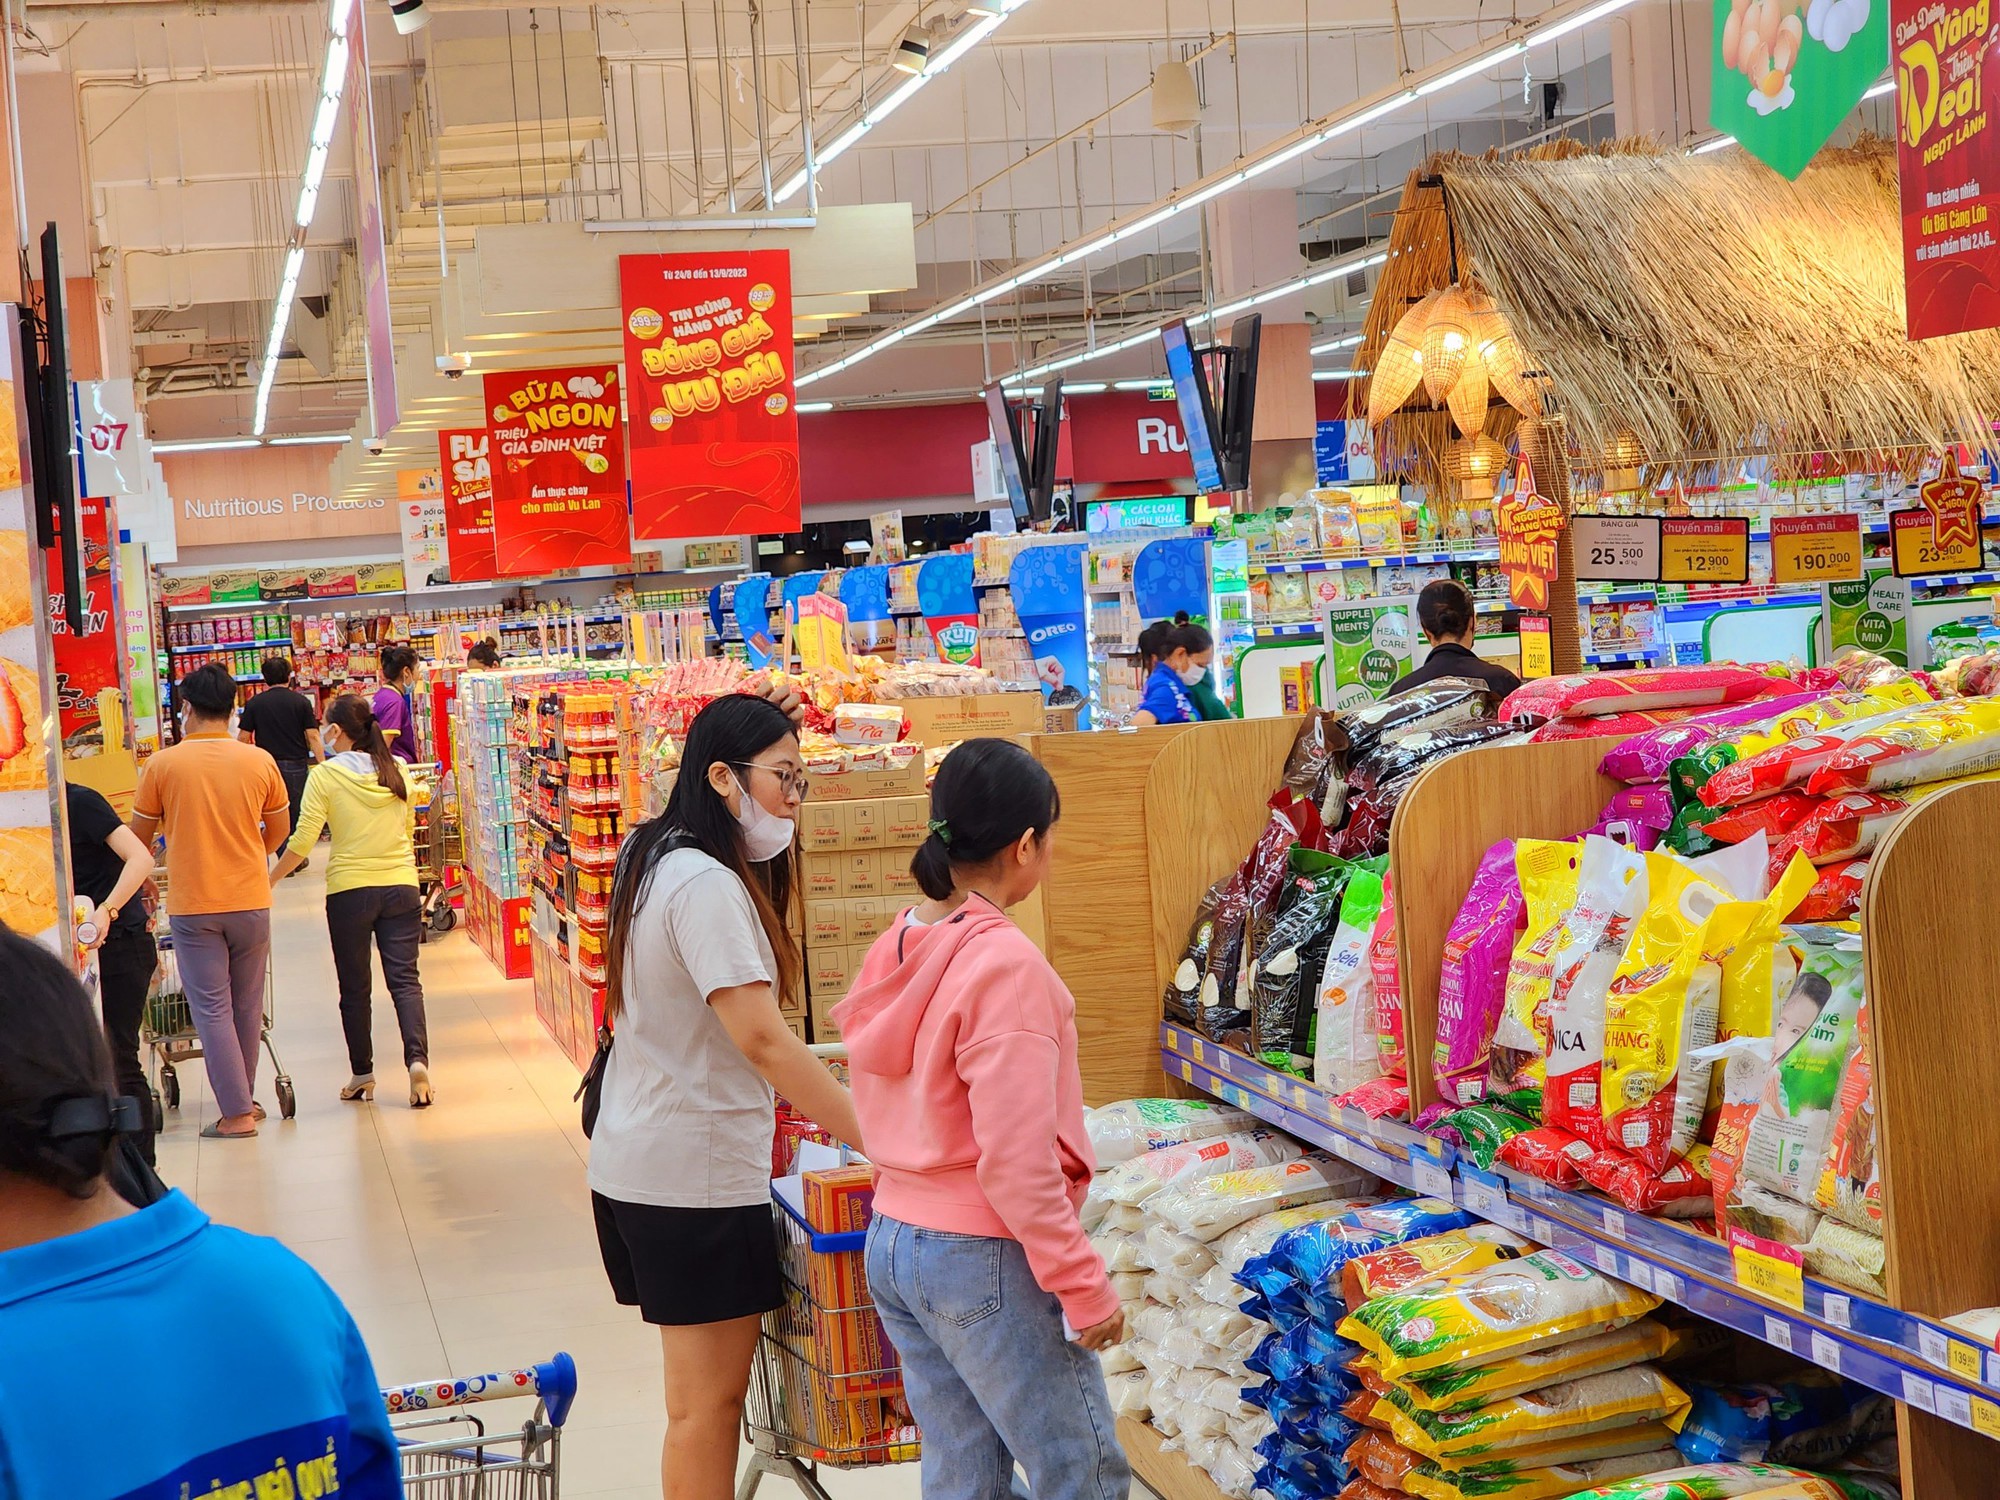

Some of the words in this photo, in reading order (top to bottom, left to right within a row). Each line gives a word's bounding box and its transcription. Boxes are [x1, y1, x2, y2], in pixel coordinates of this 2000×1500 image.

[1923, 131, 1953, 167] NGỌT
[1956, 111, 1987, 146] LÀNH
[1926, 192, 1942, 208] Mua
[1942, 187, 1959, 204] càng
[1934, 212, 1948, 233] Đãi
[1949, 208, 1970, 229] Càng
[1971, 203, 1988, 225] Lớn
[674, 269, 692, 280] 24/8
[693, 268, 708, 279] đến
[709, 267, 748, 279] 13/9/2023
[669, 307, 693, 323] TIN
[695, 296, 732, 317] DÙNG
[673, 319, 713, 338] HÀNG
[714, 307, 744, 328] VIỆT
[642, 337, 722, 377] ĐỒNG
[721, 311, 774, 358] GIÁ
[721, 351, 786, 404] ĐÃI
[509, 379, 568, 411] BỮA
[525, 402, 616, 434] NGON
[90, 423, 128, 451] 07
[494, 427, 529, 440] TRIỆU
[501, 440, 529, 455] GIA
[530, 436, 570, 453] ĐÌNH
[572, 433, 607, 452] VIỆT
[1350, 442, 1370, 457] 06
[567, 485, 589, 497] chay
[184, 497, 284, 520] Nutritious
[521, 502, 541, 515] cho
[543, 500, 566, 513] mùa
[568, 499, 581, 511] Vu
[582, 498, 601, 510] Lan
[1130, 504, 1151, 515] CÁC
[1539, 508, 1561, 518] SAO
[1155, 513, 1181, 526] KHÁC
[1512, 521, 1540, 535] HÀNG
[1541, 516, 1565, 530] VIỆT
[1625, 519, 1639, 528] GIÁ
[1703, 521, 1724, 533] mãi
[1773, 520, 1814, 534] Khuyến
[1816, 519, 1837, 531] mãi
[1499, 535, 1528, 565] HÀNG
[1529, 541, 1555, 576] VIỆT
[1833, 584, 1866, 595] MENTS
[1876, 601, 1902, 611] CARE
[1332, 608, 1371, 621] SUPPLE
[1335, 621, 1370, 632] MENTS
[1863, 618, 1886, 630] VITA
[1030, 622, 1077, 644] OREO
[1861, 632, 1883, 643] MIN
[1380, 638, 1408, 649] CARE
[1367, 656, 1391, 668] VITA
[1366, 671, 1388, 682] MIN
